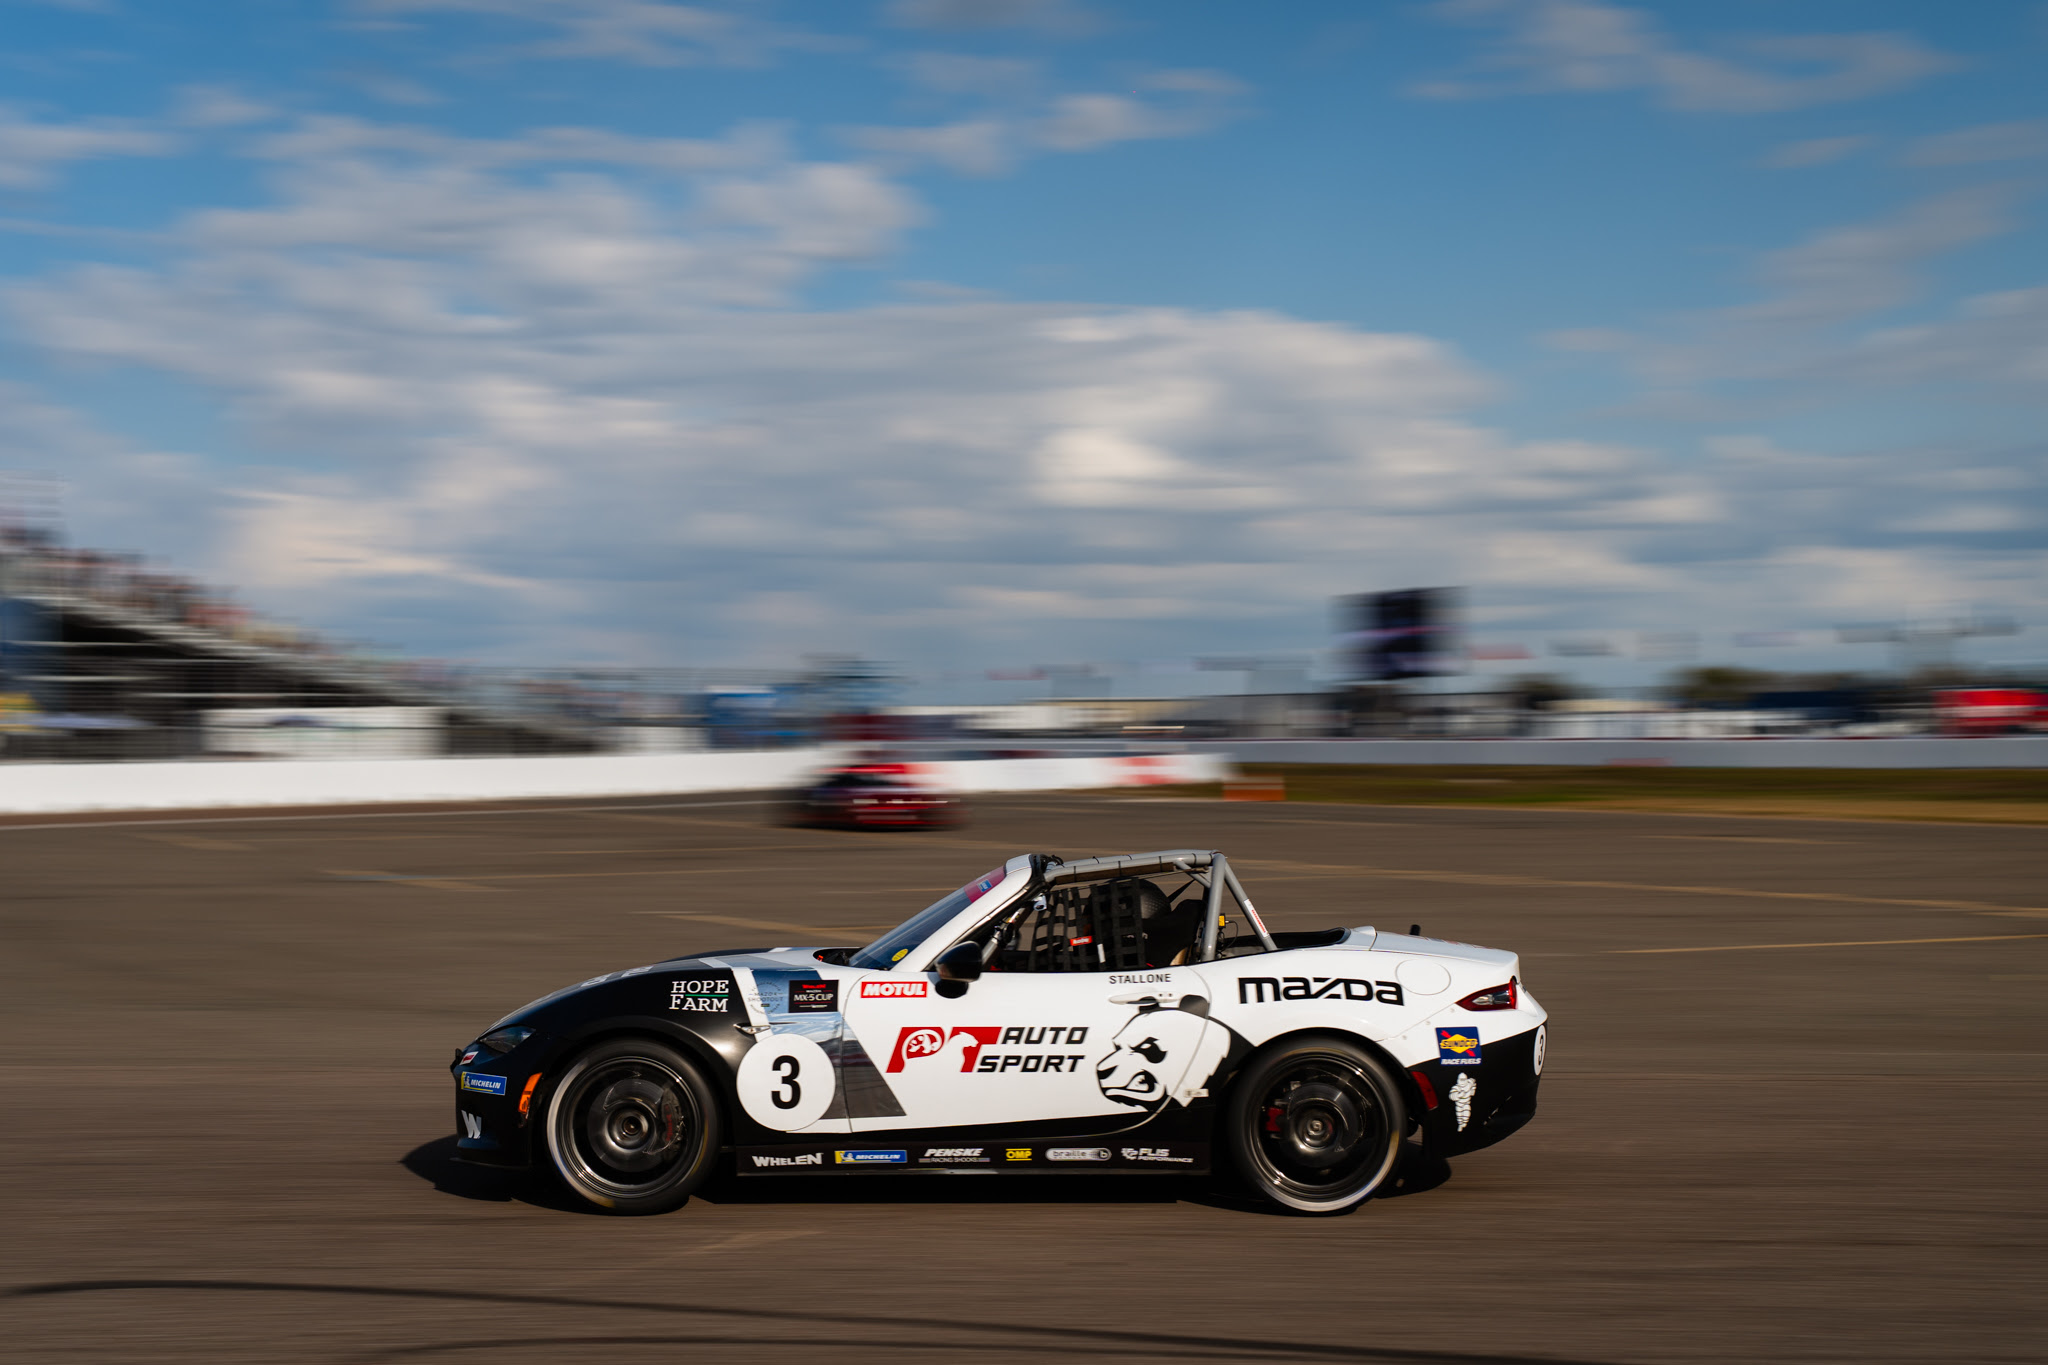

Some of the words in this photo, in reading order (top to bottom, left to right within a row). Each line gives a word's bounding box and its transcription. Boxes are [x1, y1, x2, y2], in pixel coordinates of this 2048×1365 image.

[1109, 973, 1172, 985] STALLONE
[671, 980, 729, 994] HOPE
[863, 983, 925, 996] MOTUL
[669, 994, 729, 1013] FARM
[793, 993, 815, 1002] MX-5
[815, 993, 834, 1001] CUP
[1001, 1027, 1088, 1044] AUTO
[1440, 1039, 1478, 1048] SUNOCO
[977, 1055, 1085, 1072] SPORT
[470, 1079, 502, 1089] MICHELIN
[771, 1055, 801, 1110] 3
[924, 1148, 984, 1157] PENSKE
[1006, 1150, 1032, 1159] OMP
[752, 1153, 823, 1167] WHELEN
